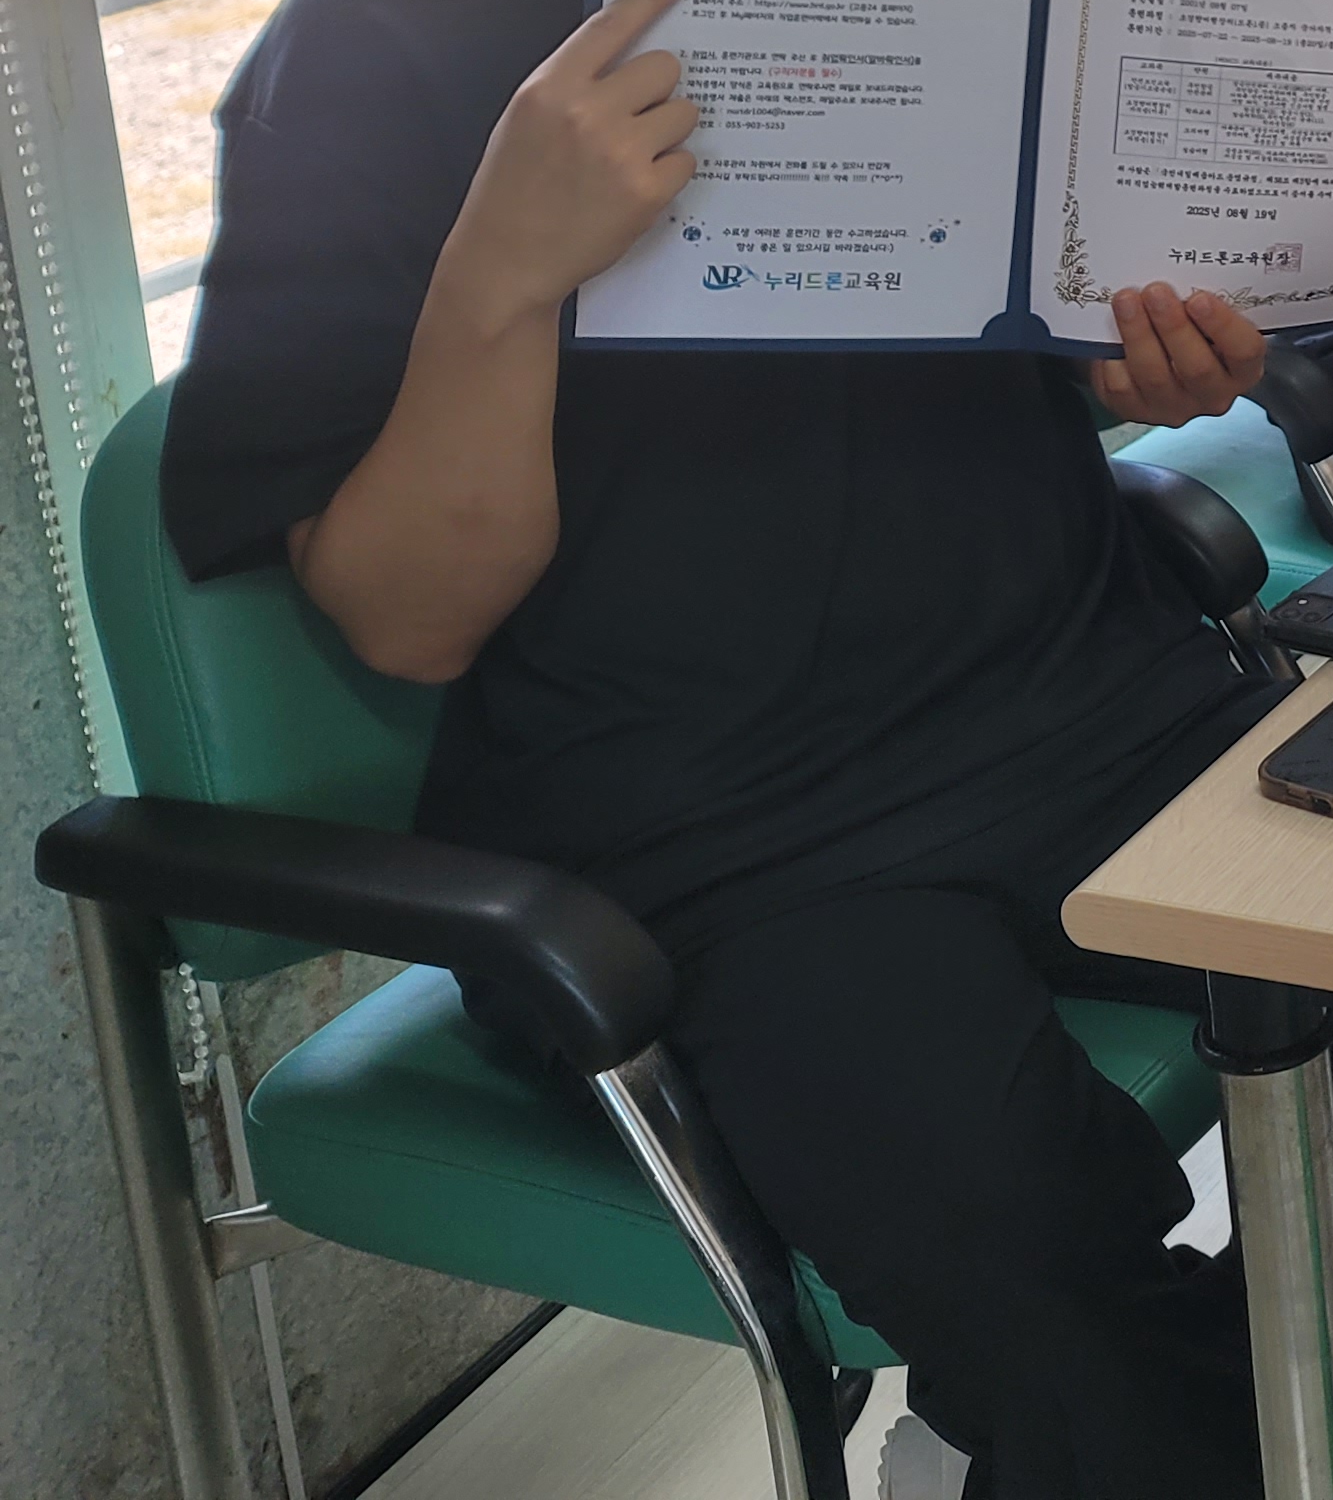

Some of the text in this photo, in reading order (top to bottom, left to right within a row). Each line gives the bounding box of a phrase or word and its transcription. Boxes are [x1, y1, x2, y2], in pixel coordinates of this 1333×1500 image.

[1186, 205, 1277, 221] 2025년 08월 19일
[754, 228, 781, 238] 여러분
[785, 228, 820, 238] 훈련기간
[763, 271, 902, 291] 누리드론교육원
